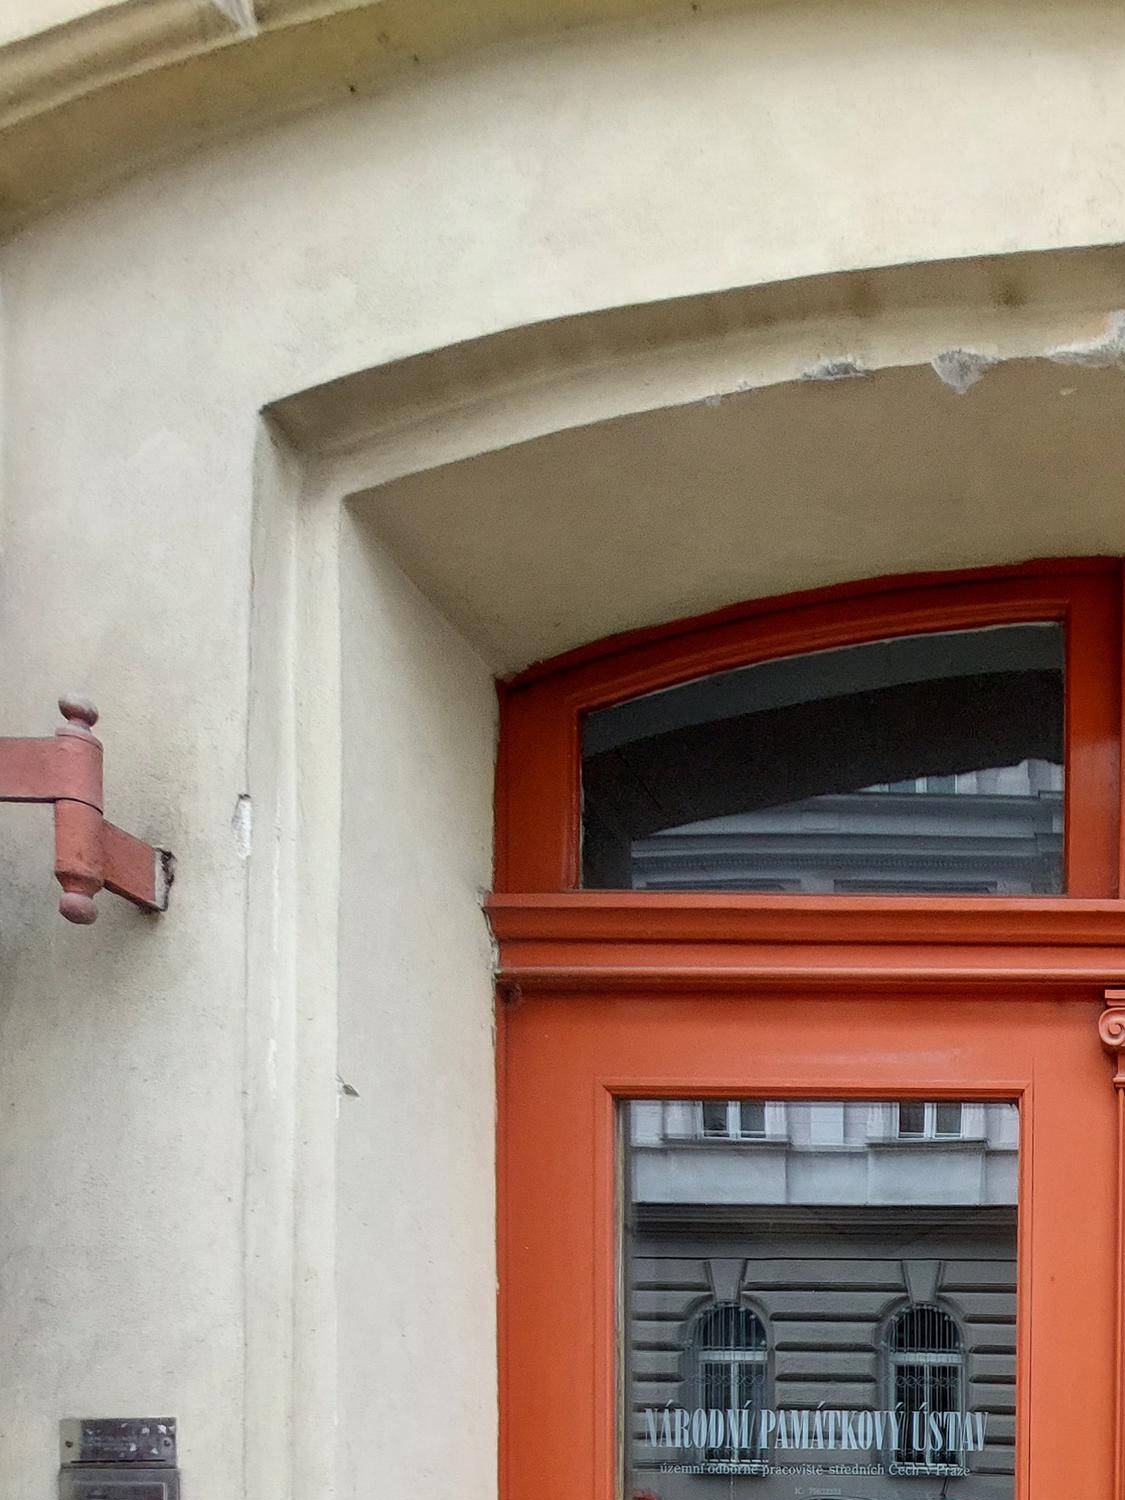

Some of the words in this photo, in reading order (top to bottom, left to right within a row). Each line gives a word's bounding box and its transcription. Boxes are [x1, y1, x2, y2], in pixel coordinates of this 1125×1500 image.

[644, 1400, 752, 1449] NÁRODNÍ
[760, 1400, 904, 1450] PAMÁTKOVÝ
[912, 1402, 989, 1451] ÚSTAV
[660, 1462, 704, 1475] územní
[762, 1464, 823, 1477] pracoviště
[829, 1463, 884, 1476] středních
[936, 1464, 970, 1477] Praze
